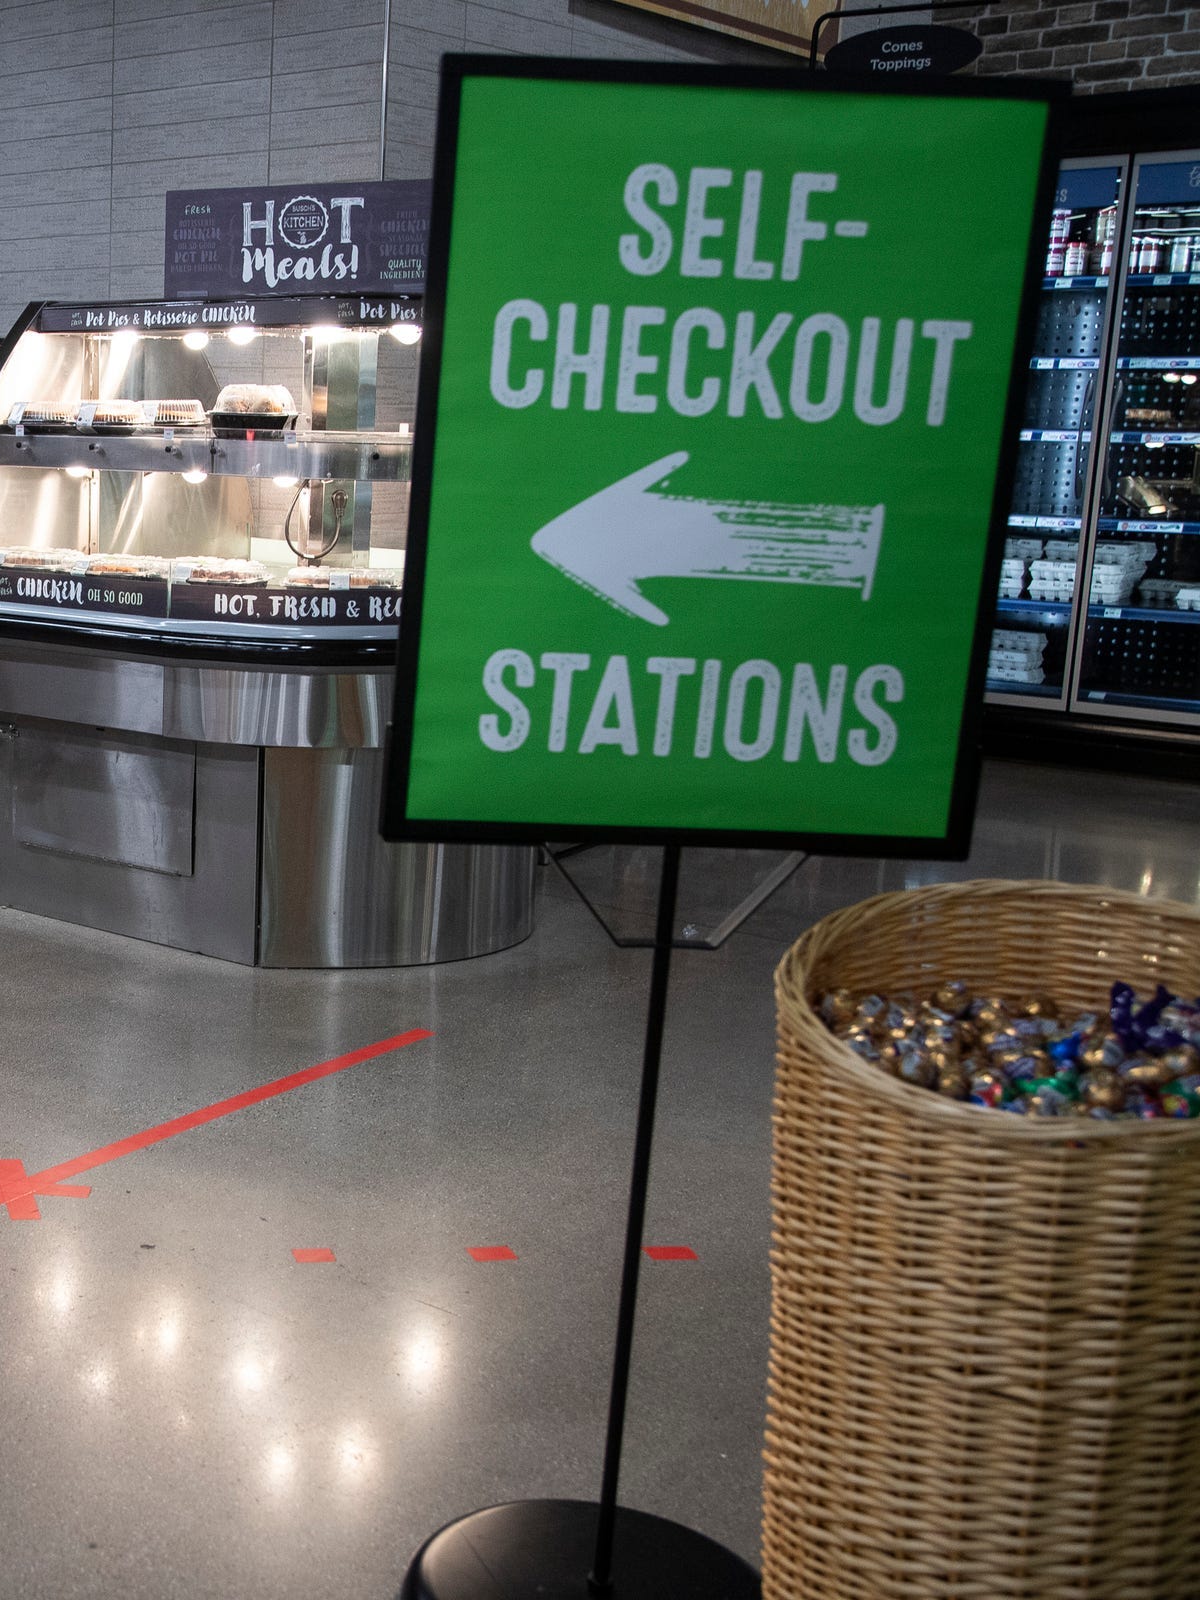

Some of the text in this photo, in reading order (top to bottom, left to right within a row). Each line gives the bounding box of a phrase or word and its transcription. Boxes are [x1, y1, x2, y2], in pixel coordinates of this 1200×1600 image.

[881, 41, 923, 53] Cones
[870, 56, 932, 72] Toppings
[292, 204, 316, 212] BUSCH'S
[283, 216, 324, 228] KITCHEN
[618, 162, 869, 281] SELF-
[241, 243, 359, 288] Meals!
[388, 259, 422, 271] QUALITY
[85, 305, 256, 328] Pot Pies & Rotisserie CHICKEN
[360, 302, 418, 320] Pot Pies
[490, 298, 973, 428] CHECKOUT
[17, 577, 143, 606] CHICKEN OH SO GOOD
[214, 593, 261, 618] HOT,
[269, 595, 337, 621] FRESH
[346, 600, 360, 618] &
[477, 648, 905, 767] STATIONS
